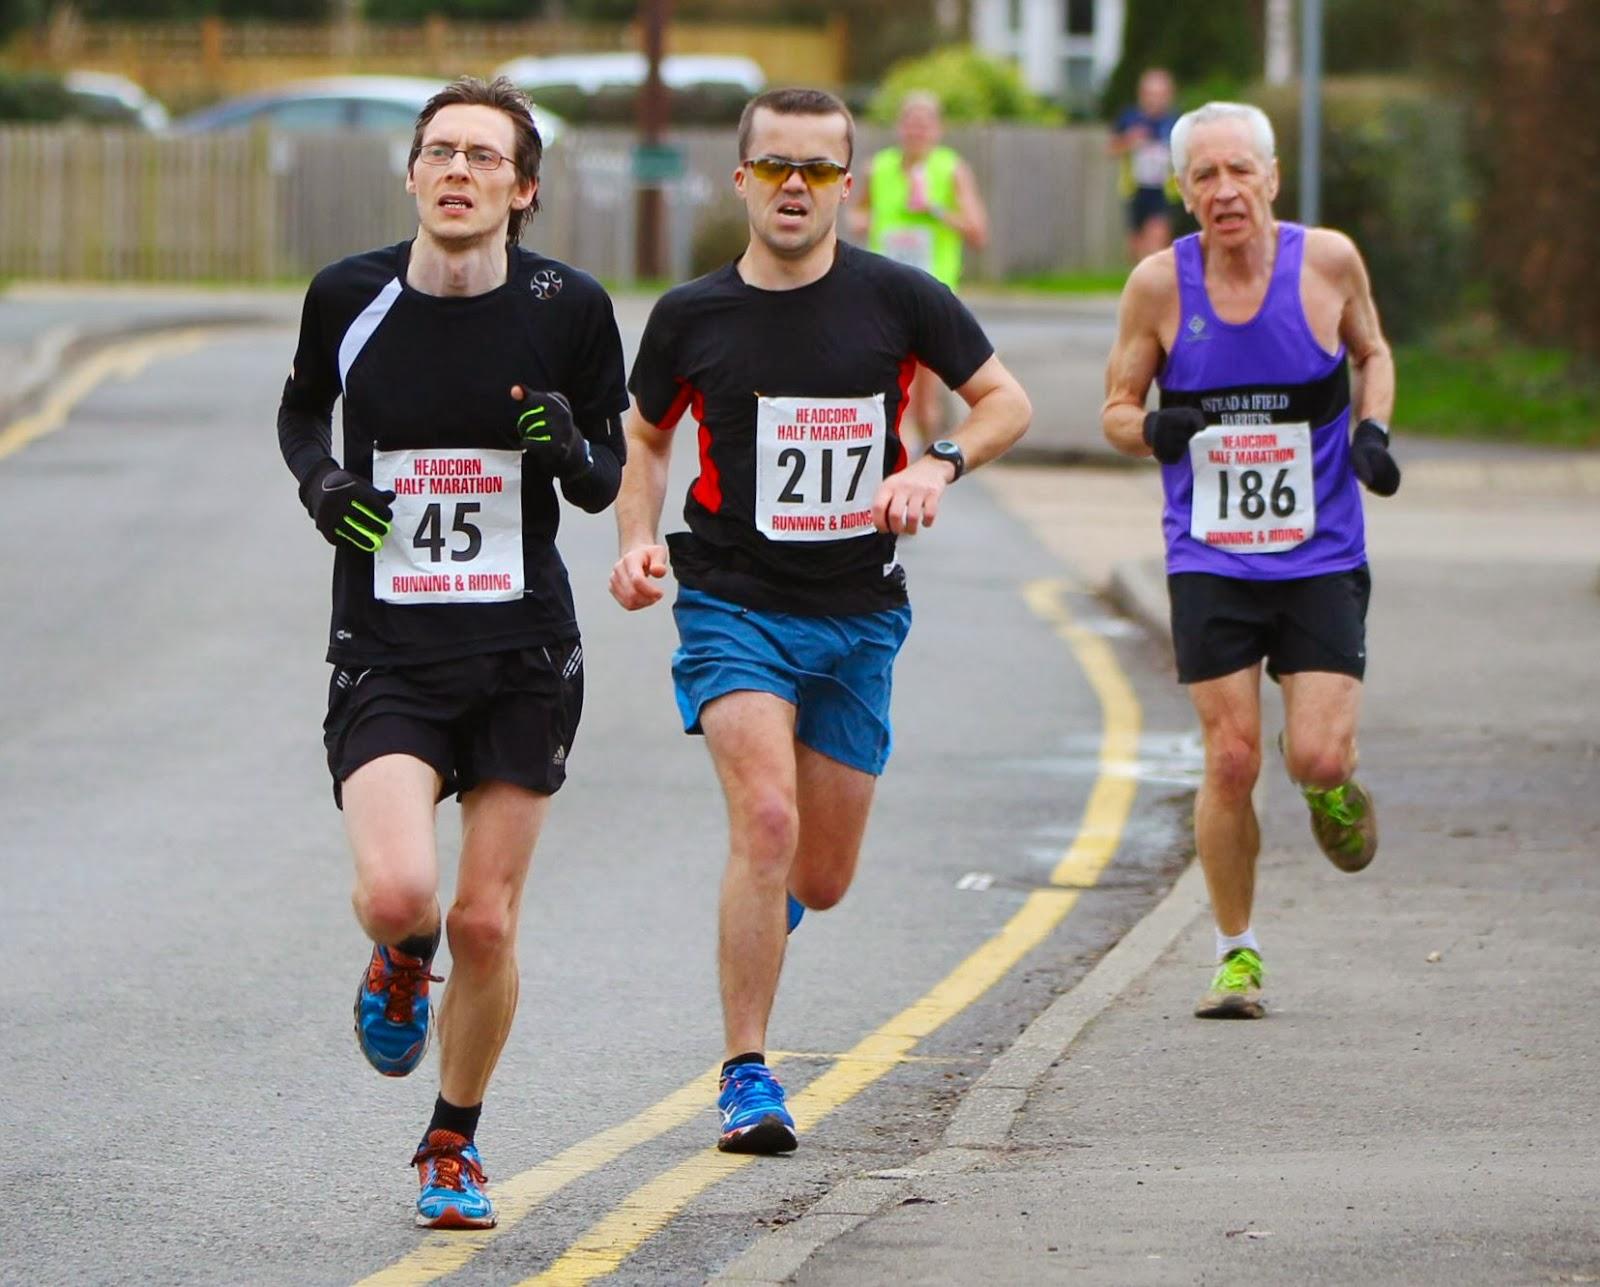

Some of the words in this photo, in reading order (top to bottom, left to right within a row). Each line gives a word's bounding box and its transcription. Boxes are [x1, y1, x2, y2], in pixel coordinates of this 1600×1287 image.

[1242, 395, 1250, 410] &
[1252, 394, 1289, 410] IFIELD
[796, 408, 857, 423] HEADCORN
[778, 425, 806, 440] HALF
[810, 424, 873, 440] MARATHON
[1222, 434, 1277, 449] HEADCORN
[1208, 451, 1232, 465] HALF
[1236, 448, 1295, 464] MARATHON
[414, 458, 482, 476] HEADCORN
[777, 445, 873, 503] 217
[394, 478, 426, 495] HALF
[430, 476, 502, 494] MARATHON
[1218, 468, 1296, 520] 186
[772, 515, 825, 531] RUNNING
[829, 516, 837, 529] &
[841, 510, 872, 529] RIDING
[413, 502, 482, 563] 45
[1206, 531, 1253, 545] RUNNING
[1258, 530, 1265, 544] &
[1269, 528, 1304, 543] RIDING
[392, 574, 451, 593] RUNNING
[455, 575, 465, 591] &
[469, 573, 512, 591] RIDING
